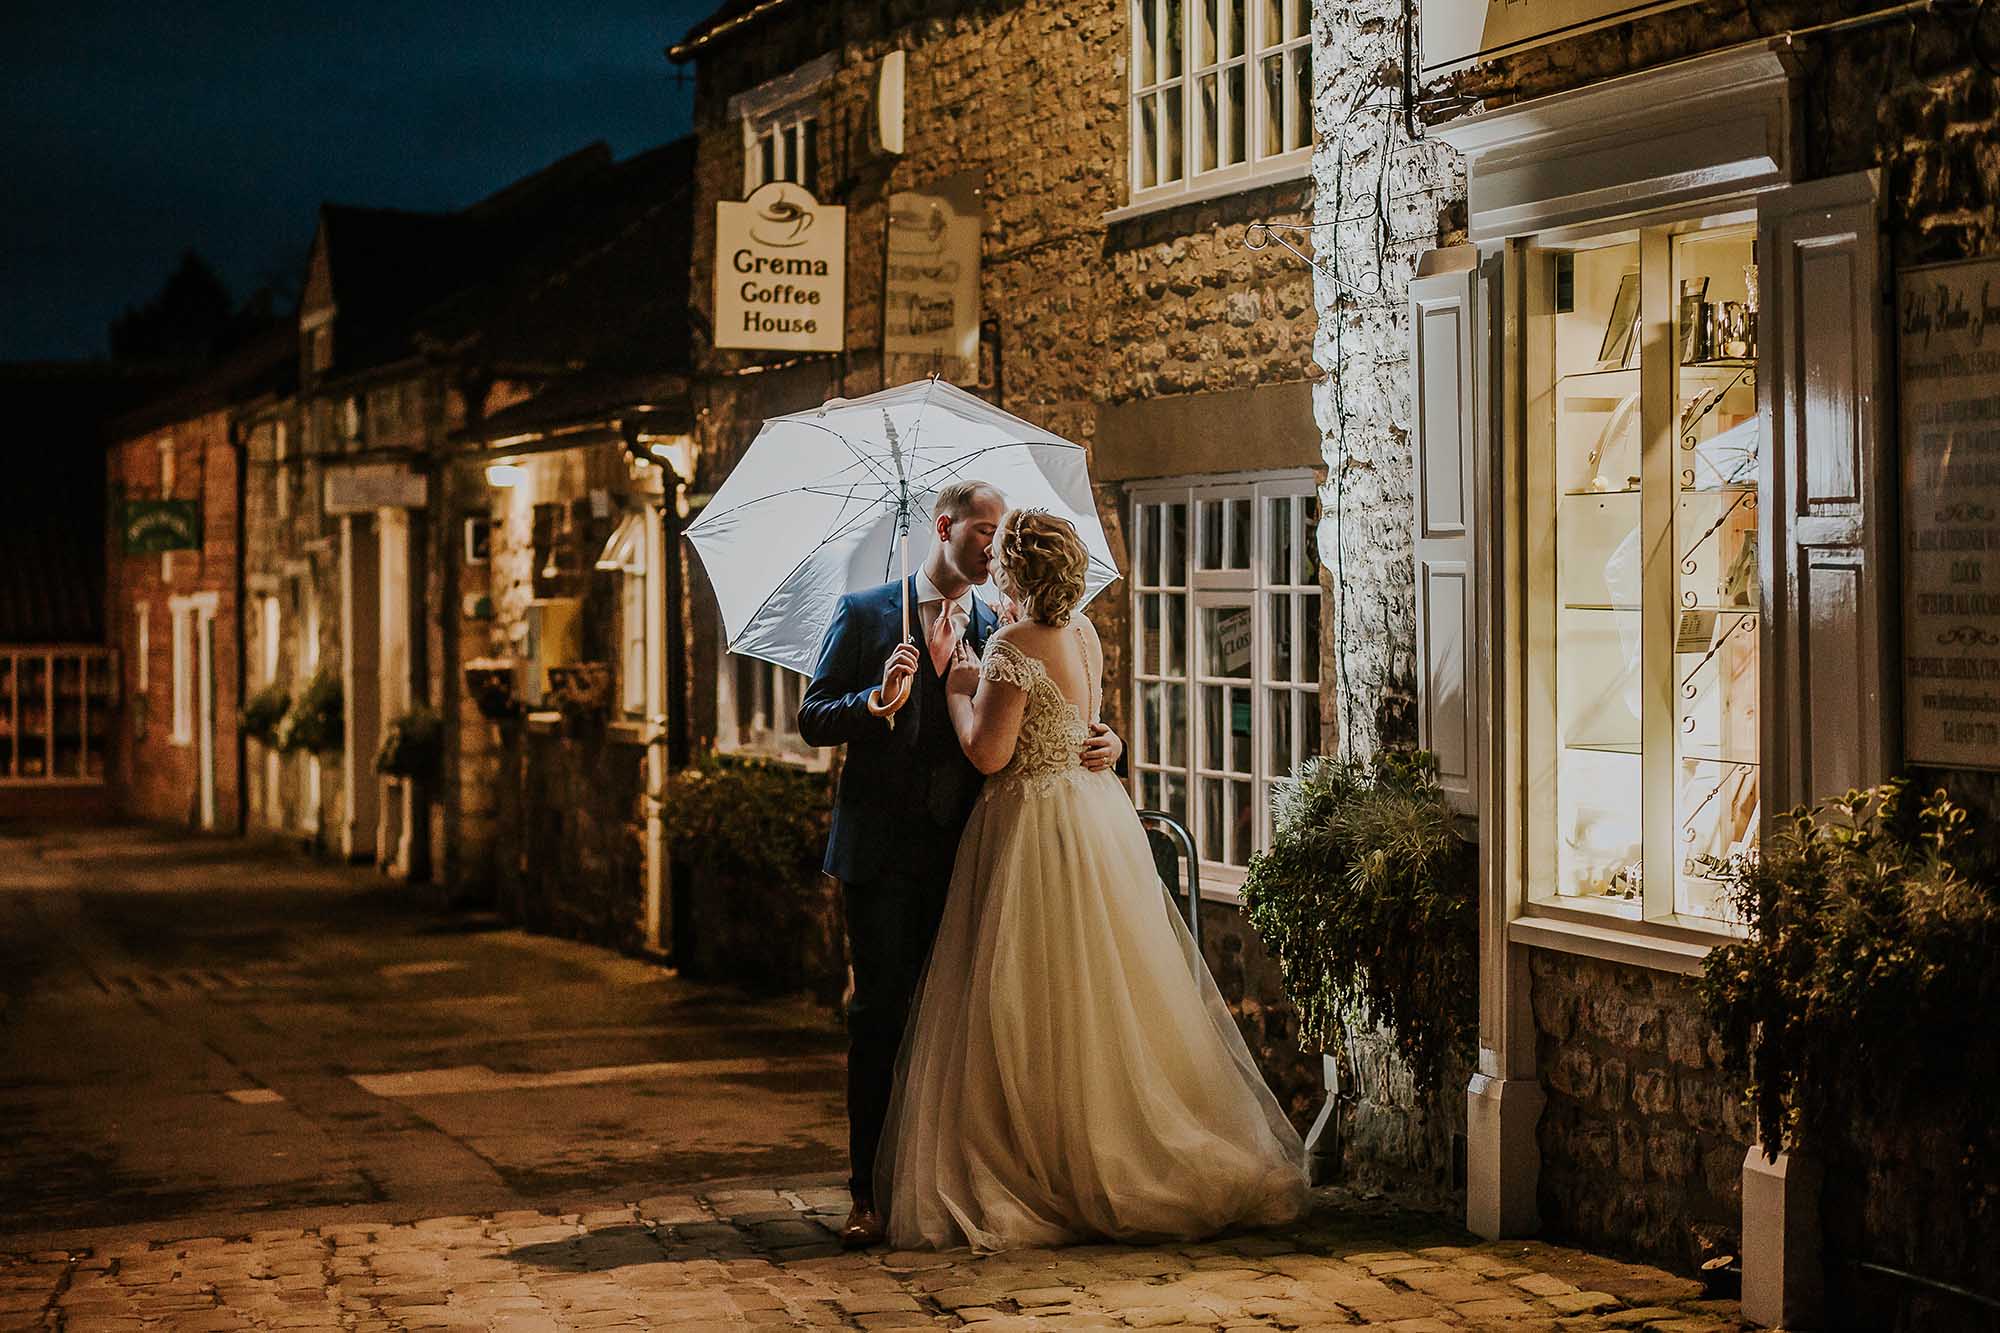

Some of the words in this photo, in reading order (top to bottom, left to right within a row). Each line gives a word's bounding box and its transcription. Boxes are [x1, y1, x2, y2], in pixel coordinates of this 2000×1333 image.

[733, 249, 828, 276] Crema
[740, 282, 820, 305] Coffee
[743, 311, 817, 334] House
